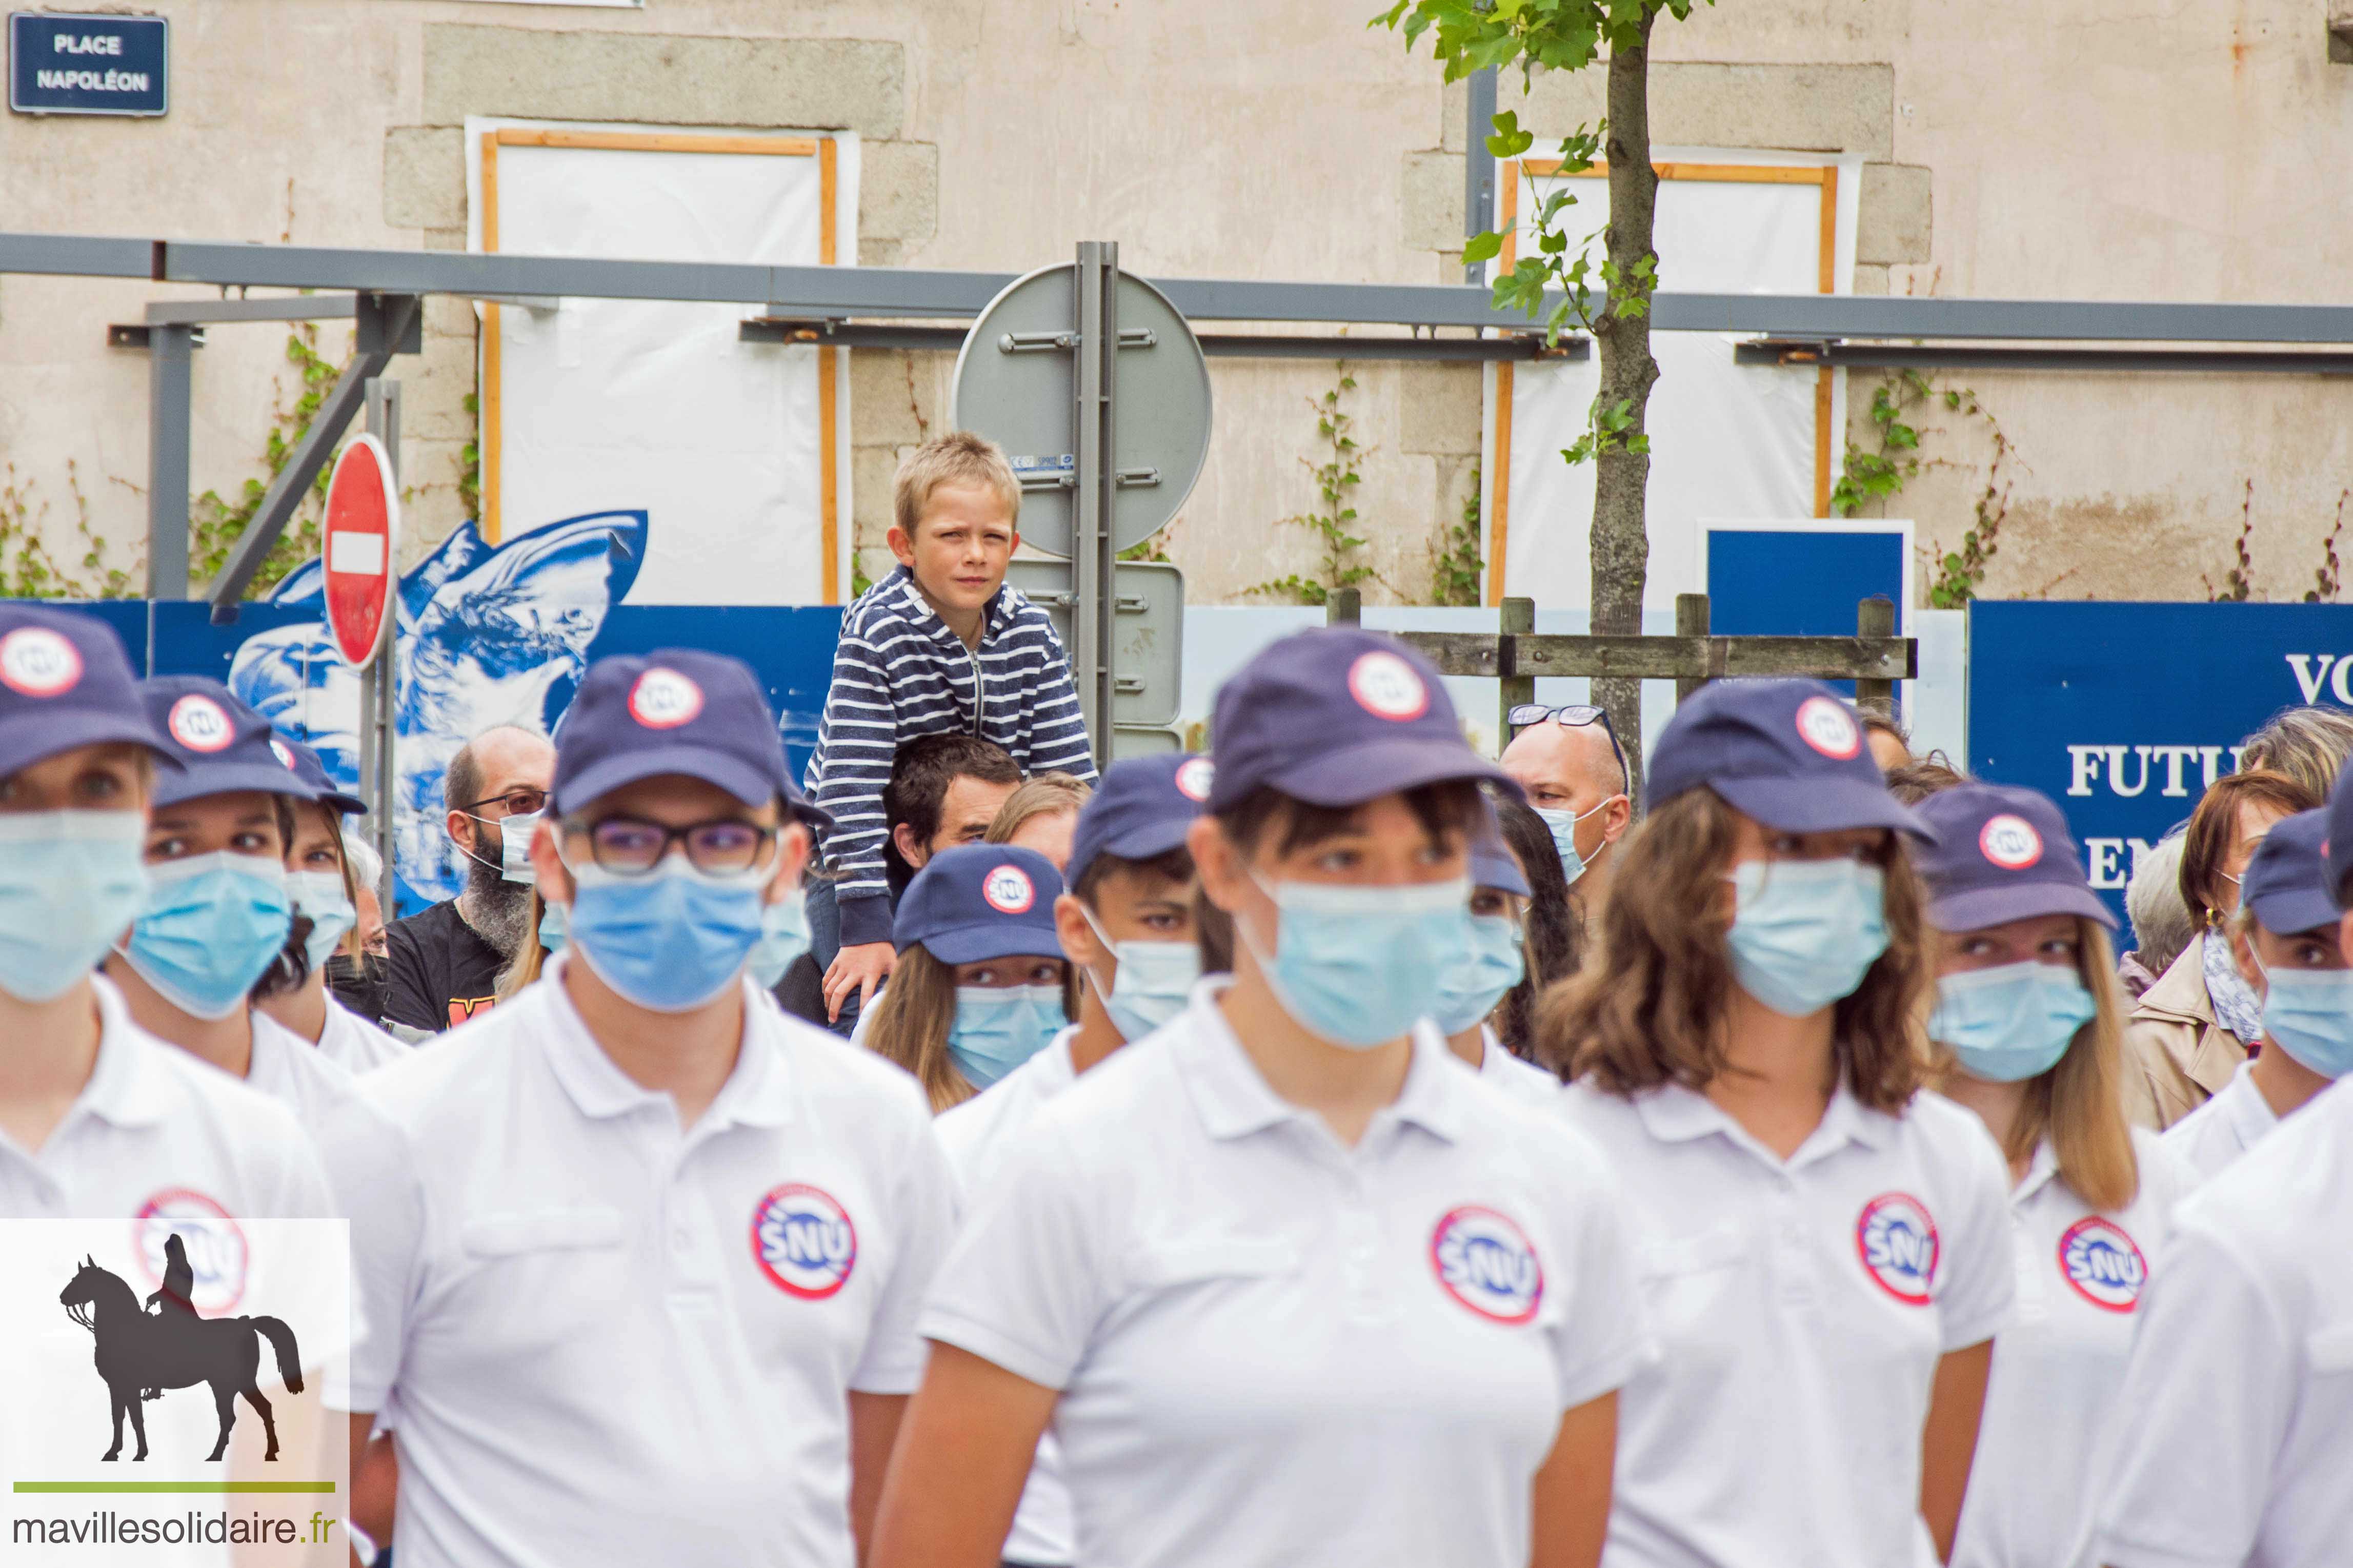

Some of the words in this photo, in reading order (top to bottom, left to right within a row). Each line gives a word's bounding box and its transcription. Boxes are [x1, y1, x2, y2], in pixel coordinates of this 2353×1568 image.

[54, 34, 122, 55] PLACE
[37, 68, 149, 92] NAPOLÉON
[759, 1219, 850, 1263] SNU
[1439, 1240, 1537, 1294] SNU
[2067, 1248, 2141, 1286] SNU
